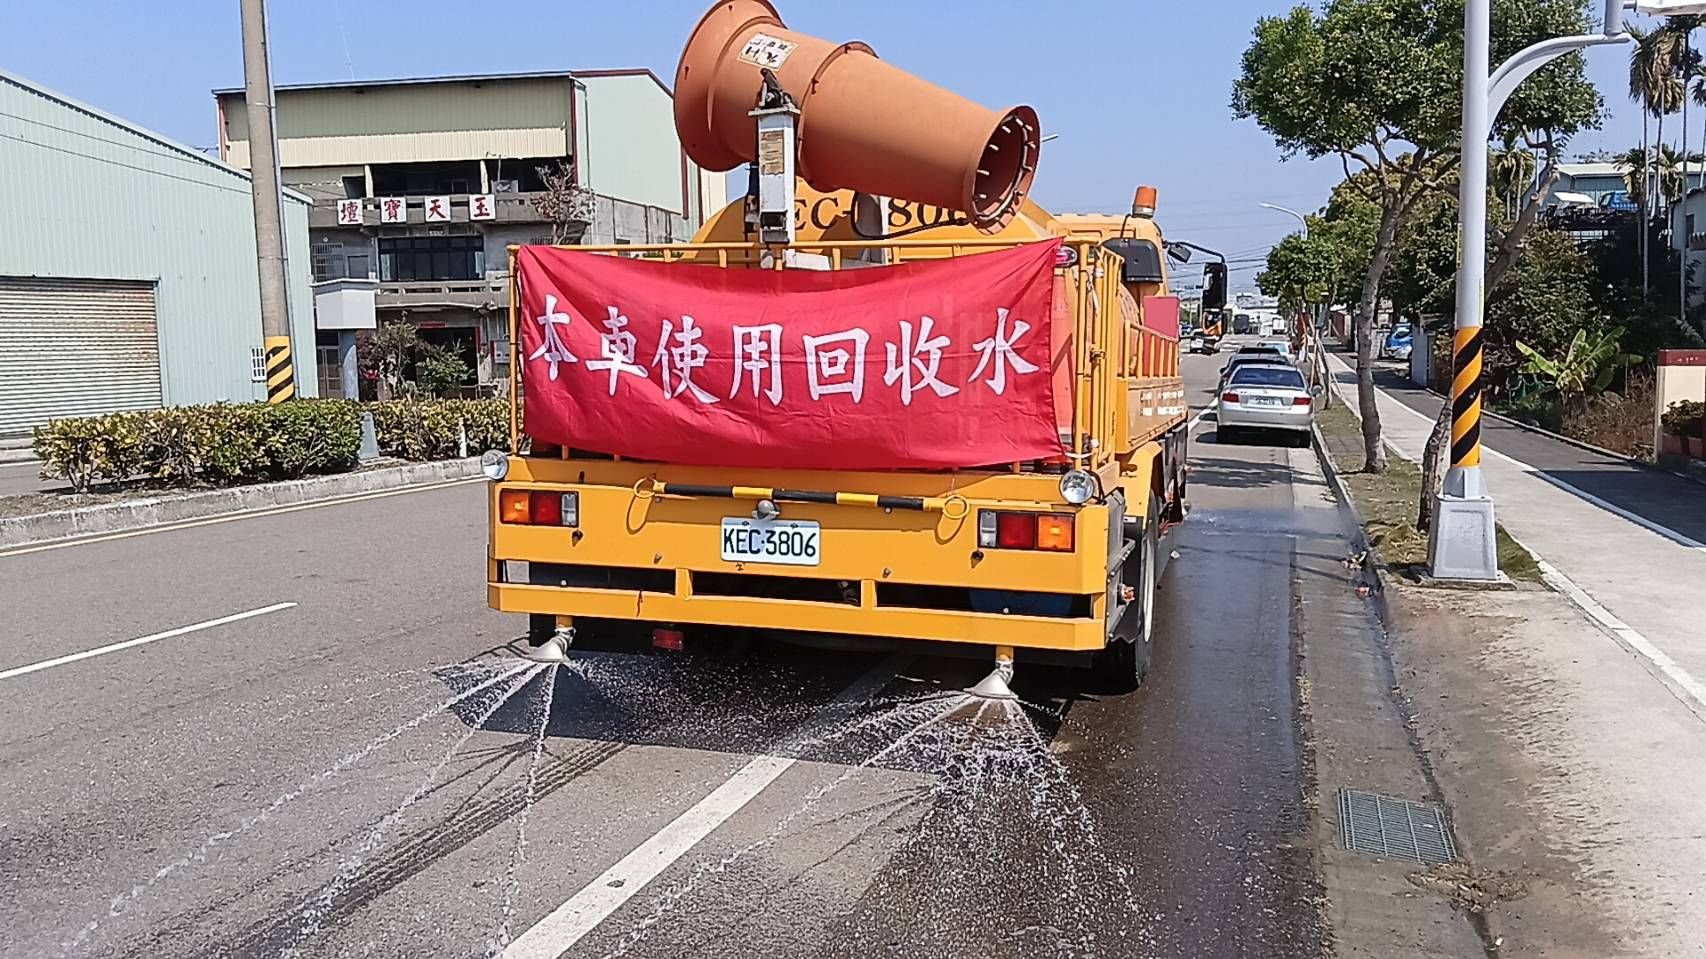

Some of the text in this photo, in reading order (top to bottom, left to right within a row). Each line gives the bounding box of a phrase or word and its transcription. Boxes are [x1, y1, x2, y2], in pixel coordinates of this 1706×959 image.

[529, 294, 1039, 405] 本車使用回收水
